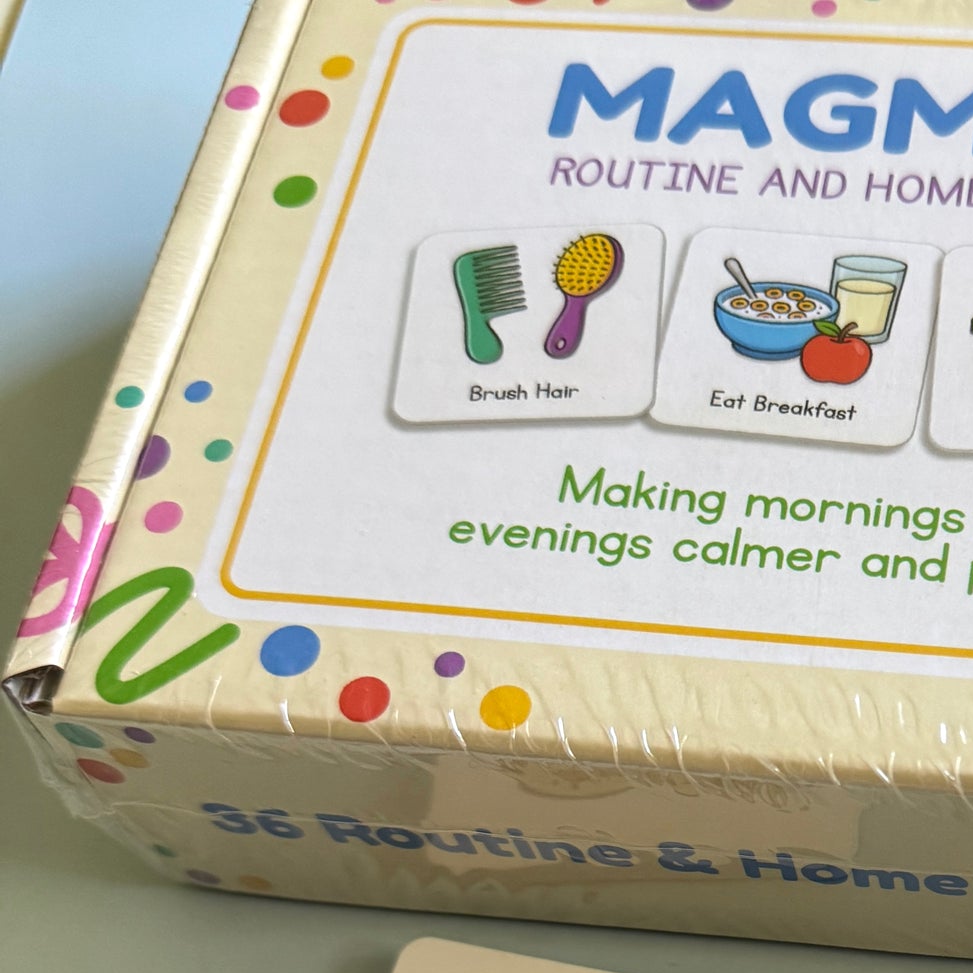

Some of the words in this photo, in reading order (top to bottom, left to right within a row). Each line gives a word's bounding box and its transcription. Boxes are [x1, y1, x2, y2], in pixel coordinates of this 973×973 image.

[550, 156, 743, 195] ROUTINE
[758, 167, 847, 200] AND
[469, 384, 528, 402] Brush
[536, 382, 579, 401] Hair
[709, 390, 745, 411] Eat
[752, 394, 857, 421] Breakfast
[558, 464, 727, 525] Making
[745, 495, 966, 537] mornings
[448, 520, 653, 567] evenings
[672, 528, 841, 573] calmer
[861, 544, 950, 582] and
[202, 802, 305, 840] 36
[314, 812, 634, 870] Routine
[657, 841, 720, 877] &
[741, 848, 969, 898] Home
